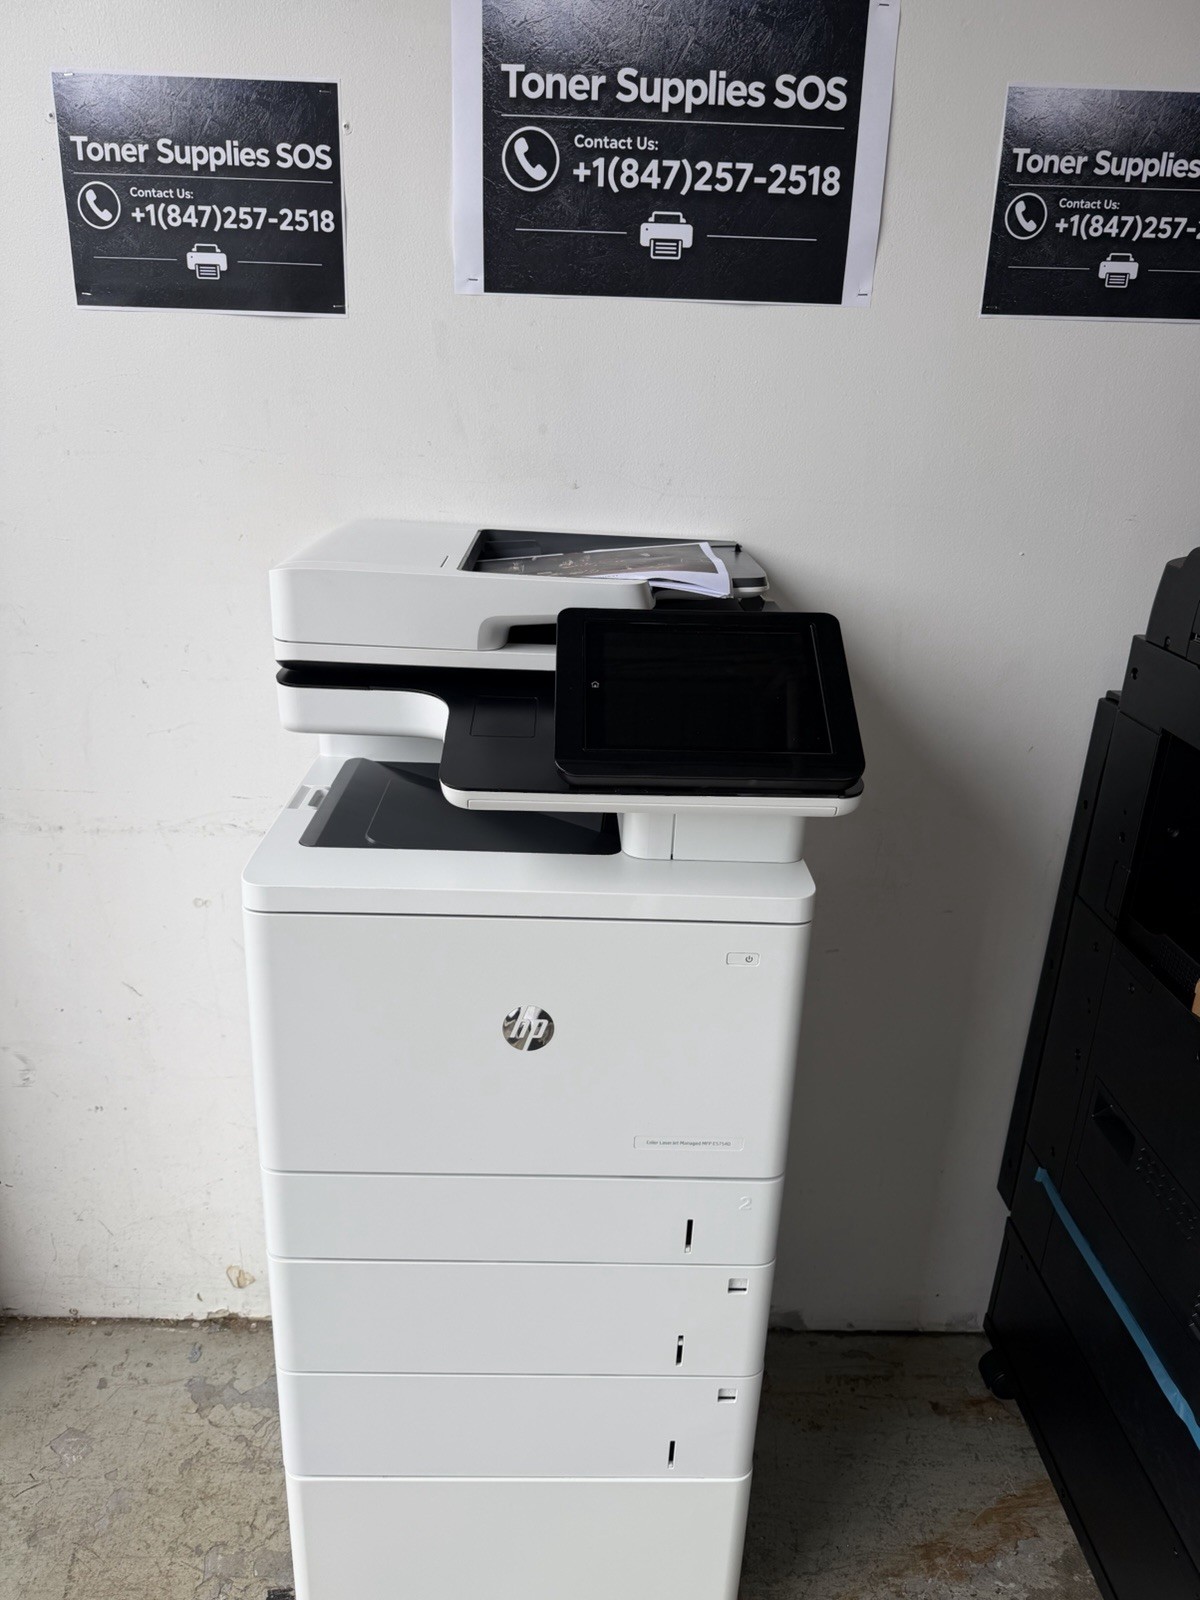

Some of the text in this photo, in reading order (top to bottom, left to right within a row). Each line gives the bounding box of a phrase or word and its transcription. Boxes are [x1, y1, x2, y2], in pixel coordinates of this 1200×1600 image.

[501, 63, 848, 114] Toner Supplies SOS
[69, 135, 333, 172] Toner Supplies SOS
[573, 134, 659, 151] Contact Us:
[572, 156, 841, 197] +1(847)257-2518
[1012, 147, 1200, 183] Toner Supplies
[129, 186, 194, 200] Contact Us:
[1059, 197, 1121, 211] Contact Us:
[130, 202, 335, 233] +1(847)257-2518
